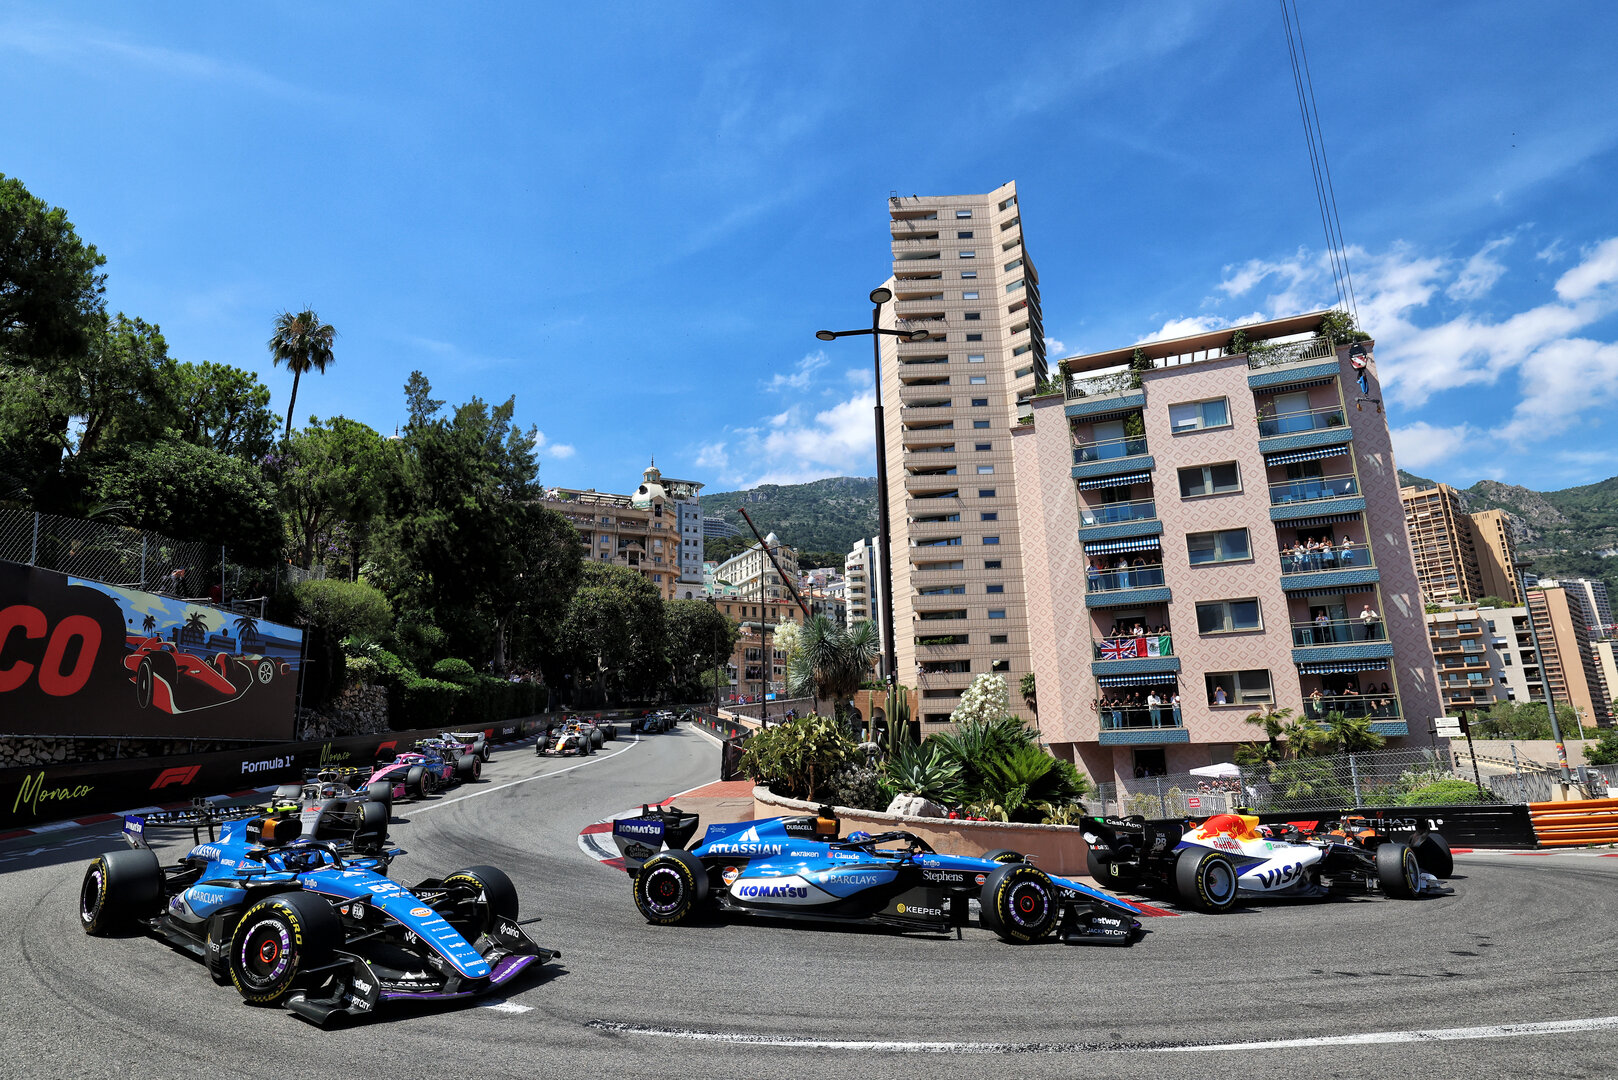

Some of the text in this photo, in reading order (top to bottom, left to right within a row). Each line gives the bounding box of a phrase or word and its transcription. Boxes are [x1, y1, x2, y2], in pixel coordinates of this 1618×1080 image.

[241, 757, 284, 774] Formula
[13, 771, 94, 815] Monaco
[1106, 819, 1125, 827] Cash
[618, 825, 661, 835] KOMATSU
[190, 844, 221, 862] ATLASSIAN
[708, 843, 782, 855] ATLASSIAN
[834, 852, 860, 860] Claude
[830, 875, 878, 884] BARCLAYS
[922, 870, 964, 882] Stephens
[1252, 861, 1303, 889] VISA
[192, 889, 224, 905] BARCLAYS
[739, 884, 808, 898] KOMATSU
[906, 905, 941, 916] KEEPER
[281, 907, 303, 945] ZERO
